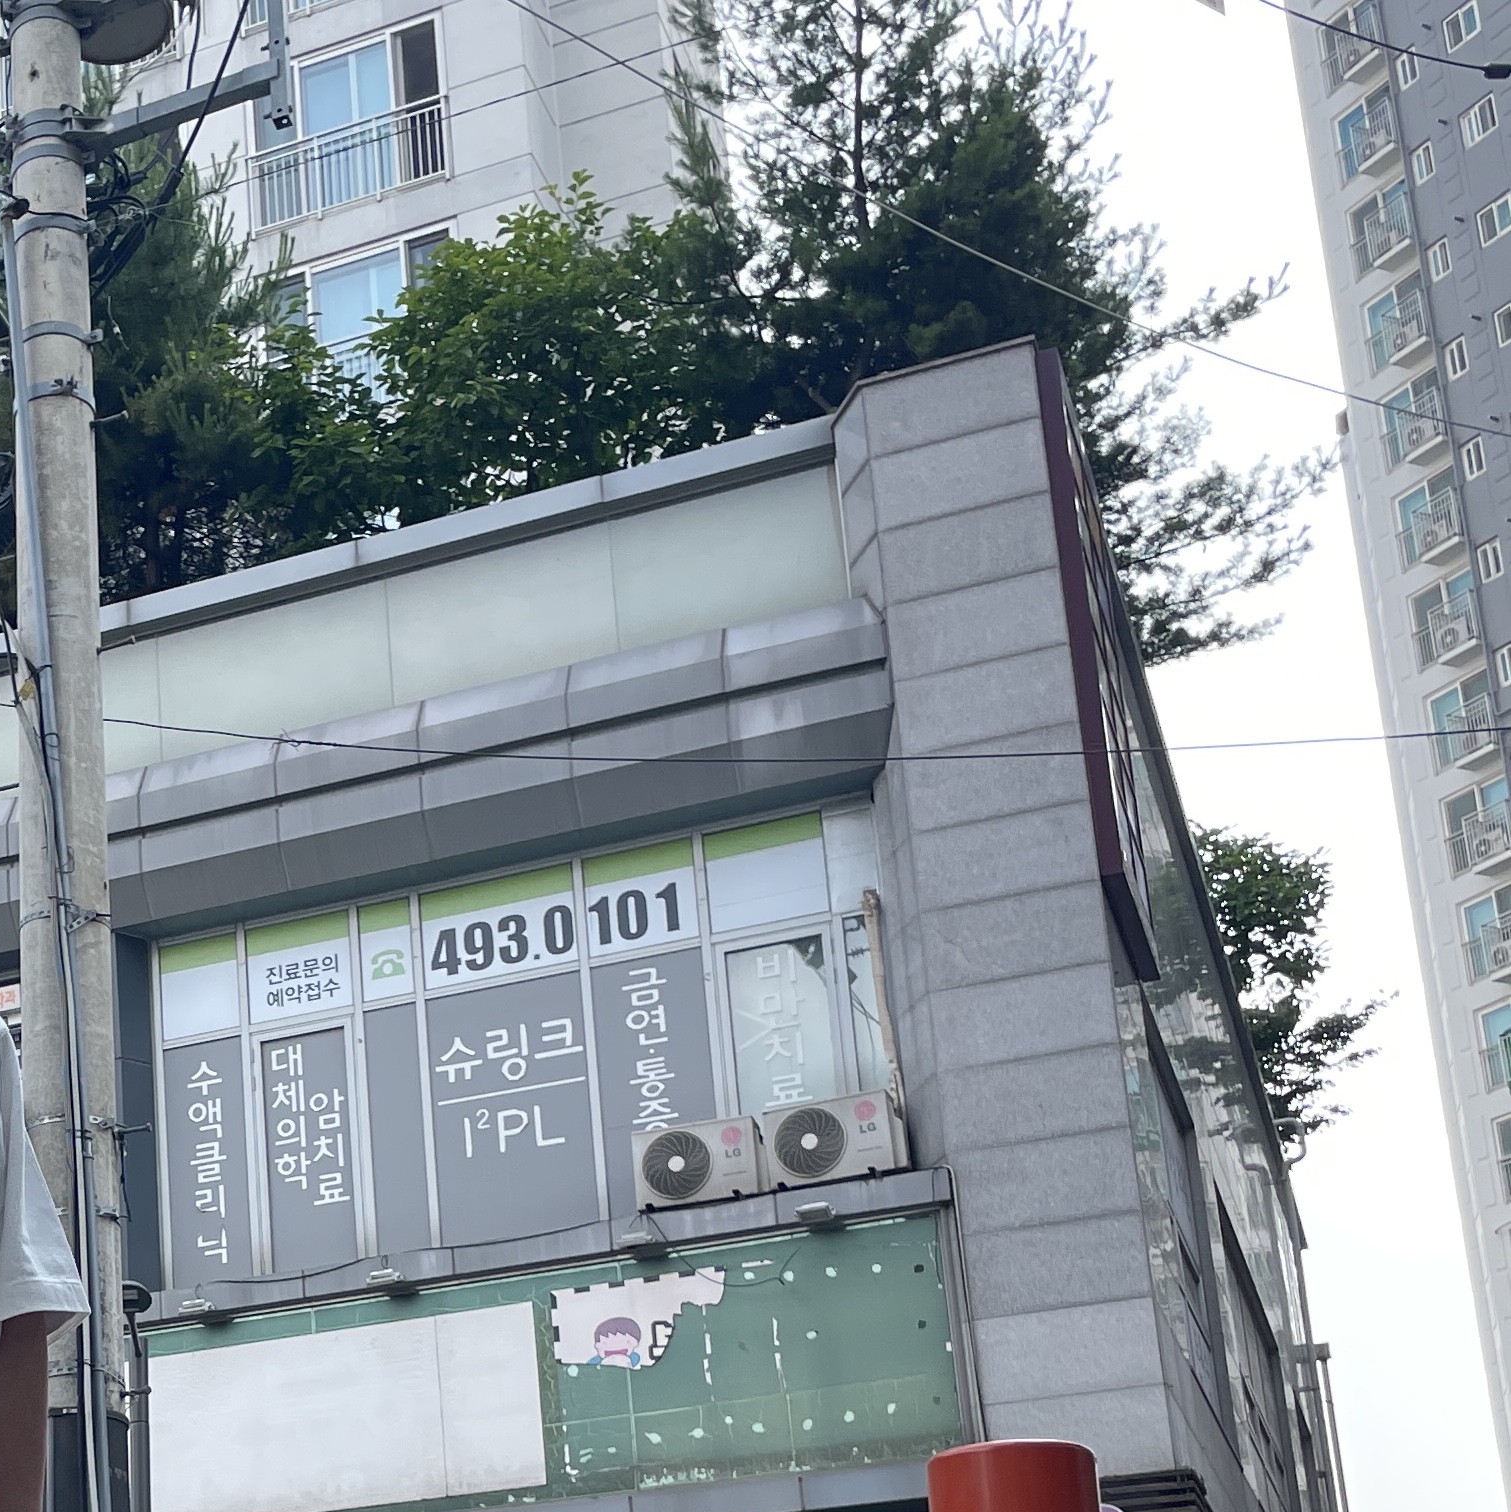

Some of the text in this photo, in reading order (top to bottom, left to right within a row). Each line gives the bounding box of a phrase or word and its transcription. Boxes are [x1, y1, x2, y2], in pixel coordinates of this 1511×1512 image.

[265, 953, 340, 986] 진료문의
[266, 978, 341, 1008] 예약접수
[435, 1016, 584, 1082] 슈링크
[270, 1043, 312, 1191] 대체의학
[859, 1122, 877, 1134] LG
[187, 1060, 228, 1264] 수액클리닉
[309, 1087, 350, 1207] 암치료
[725, 1148, 742, 1158] LG
